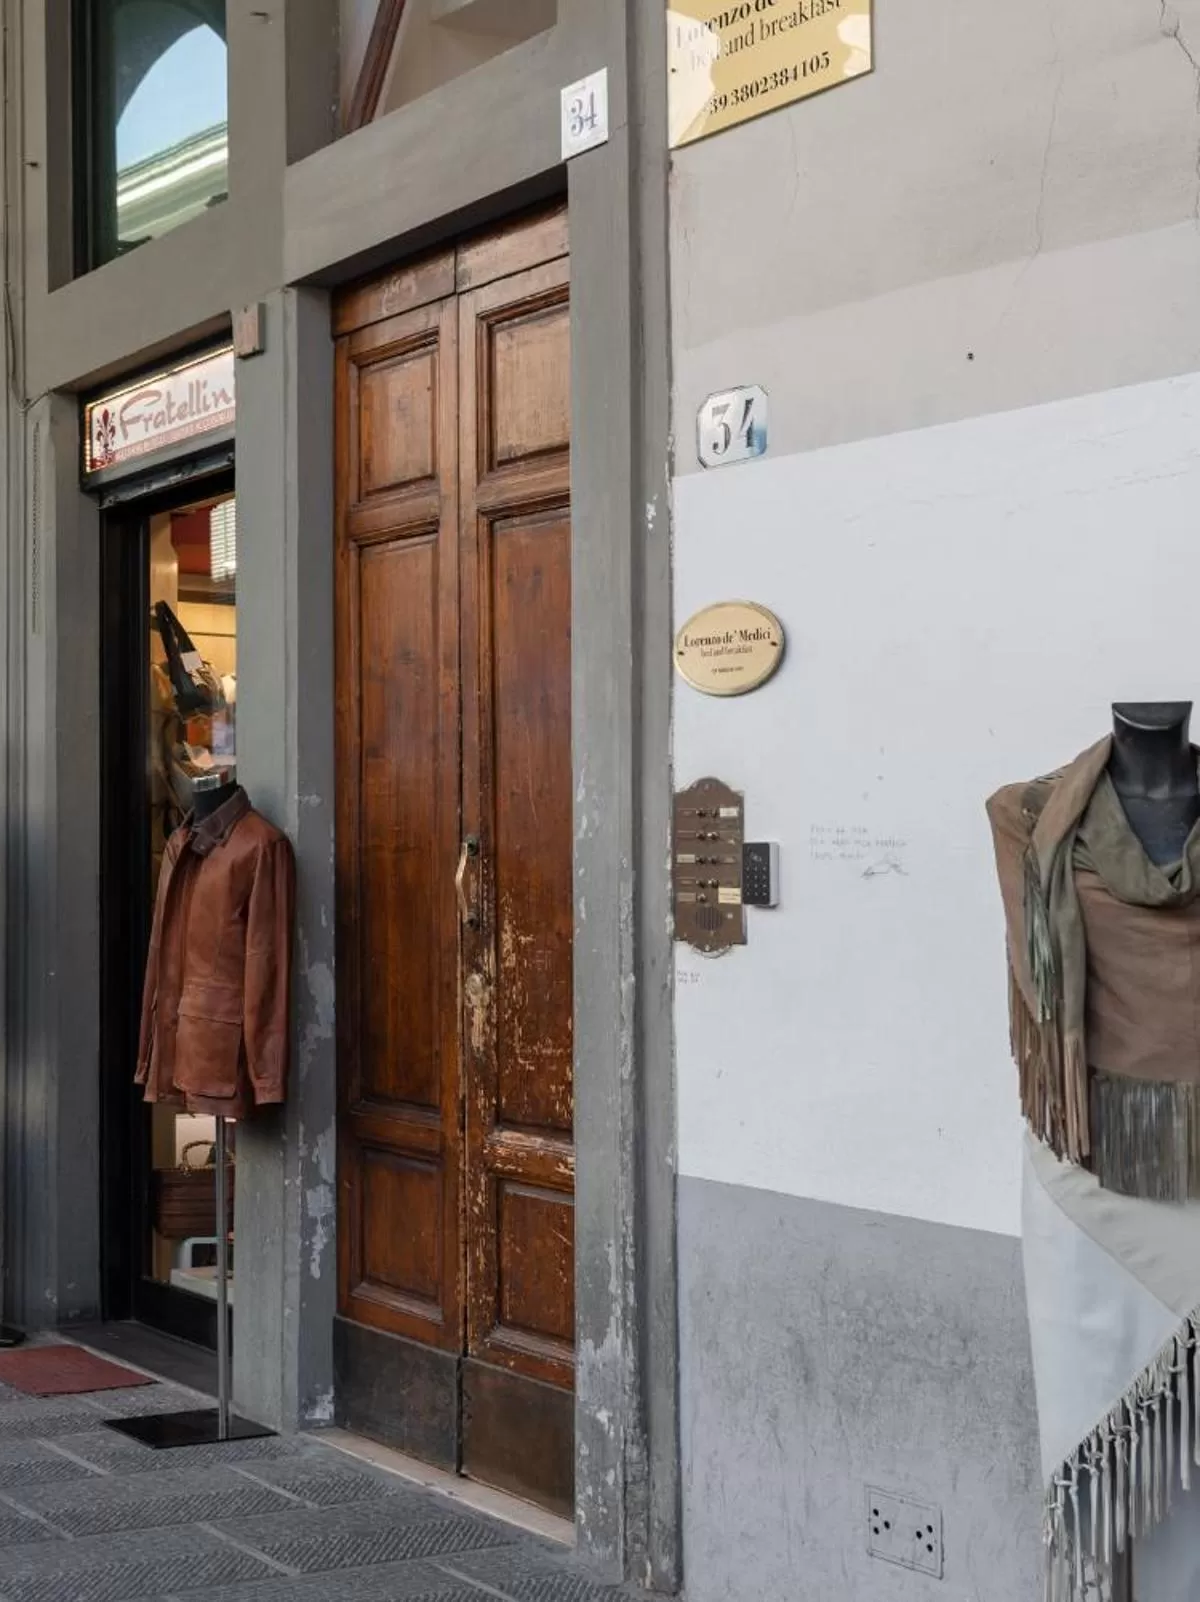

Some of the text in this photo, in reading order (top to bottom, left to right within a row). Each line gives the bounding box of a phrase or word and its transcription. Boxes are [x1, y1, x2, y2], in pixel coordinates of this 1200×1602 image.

[724, 22, 754, 57] and
[571, 91, 598, 137] 34
[119, 379, 234, 440] Fratellin
[739, 627, 771, 641] Medici
